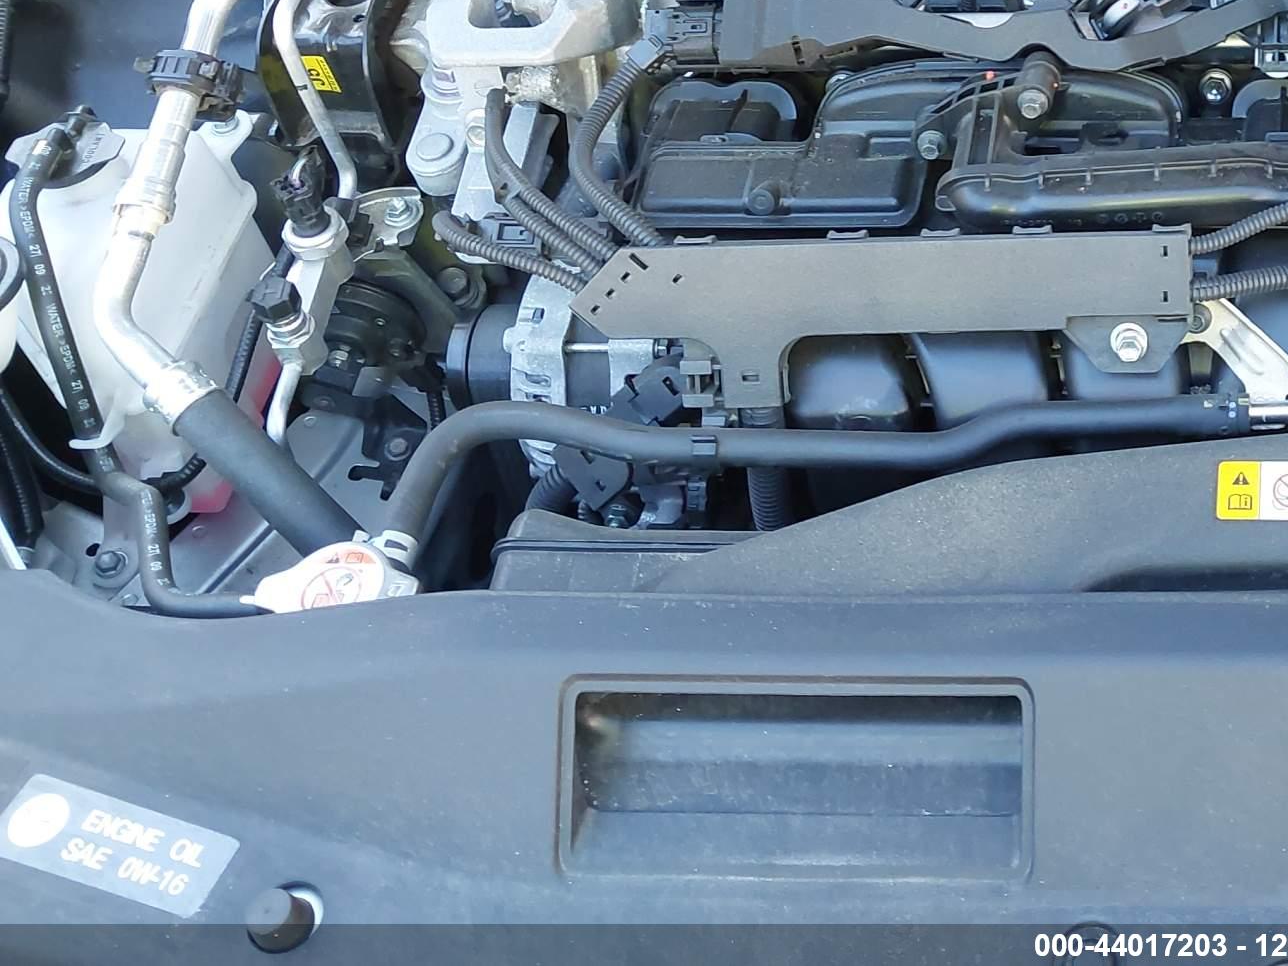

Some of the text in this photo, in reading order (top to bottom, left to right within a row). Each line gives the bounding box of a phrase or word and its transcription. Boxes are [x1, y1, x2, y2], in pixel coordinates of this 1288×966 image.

[18, 176, 33, 204] WATER
[46, 302, 65, 338] WATER
[60, 837, 189, 896] SAE 0W-16
[81, 809, 205, 868] ENGINE OIL
